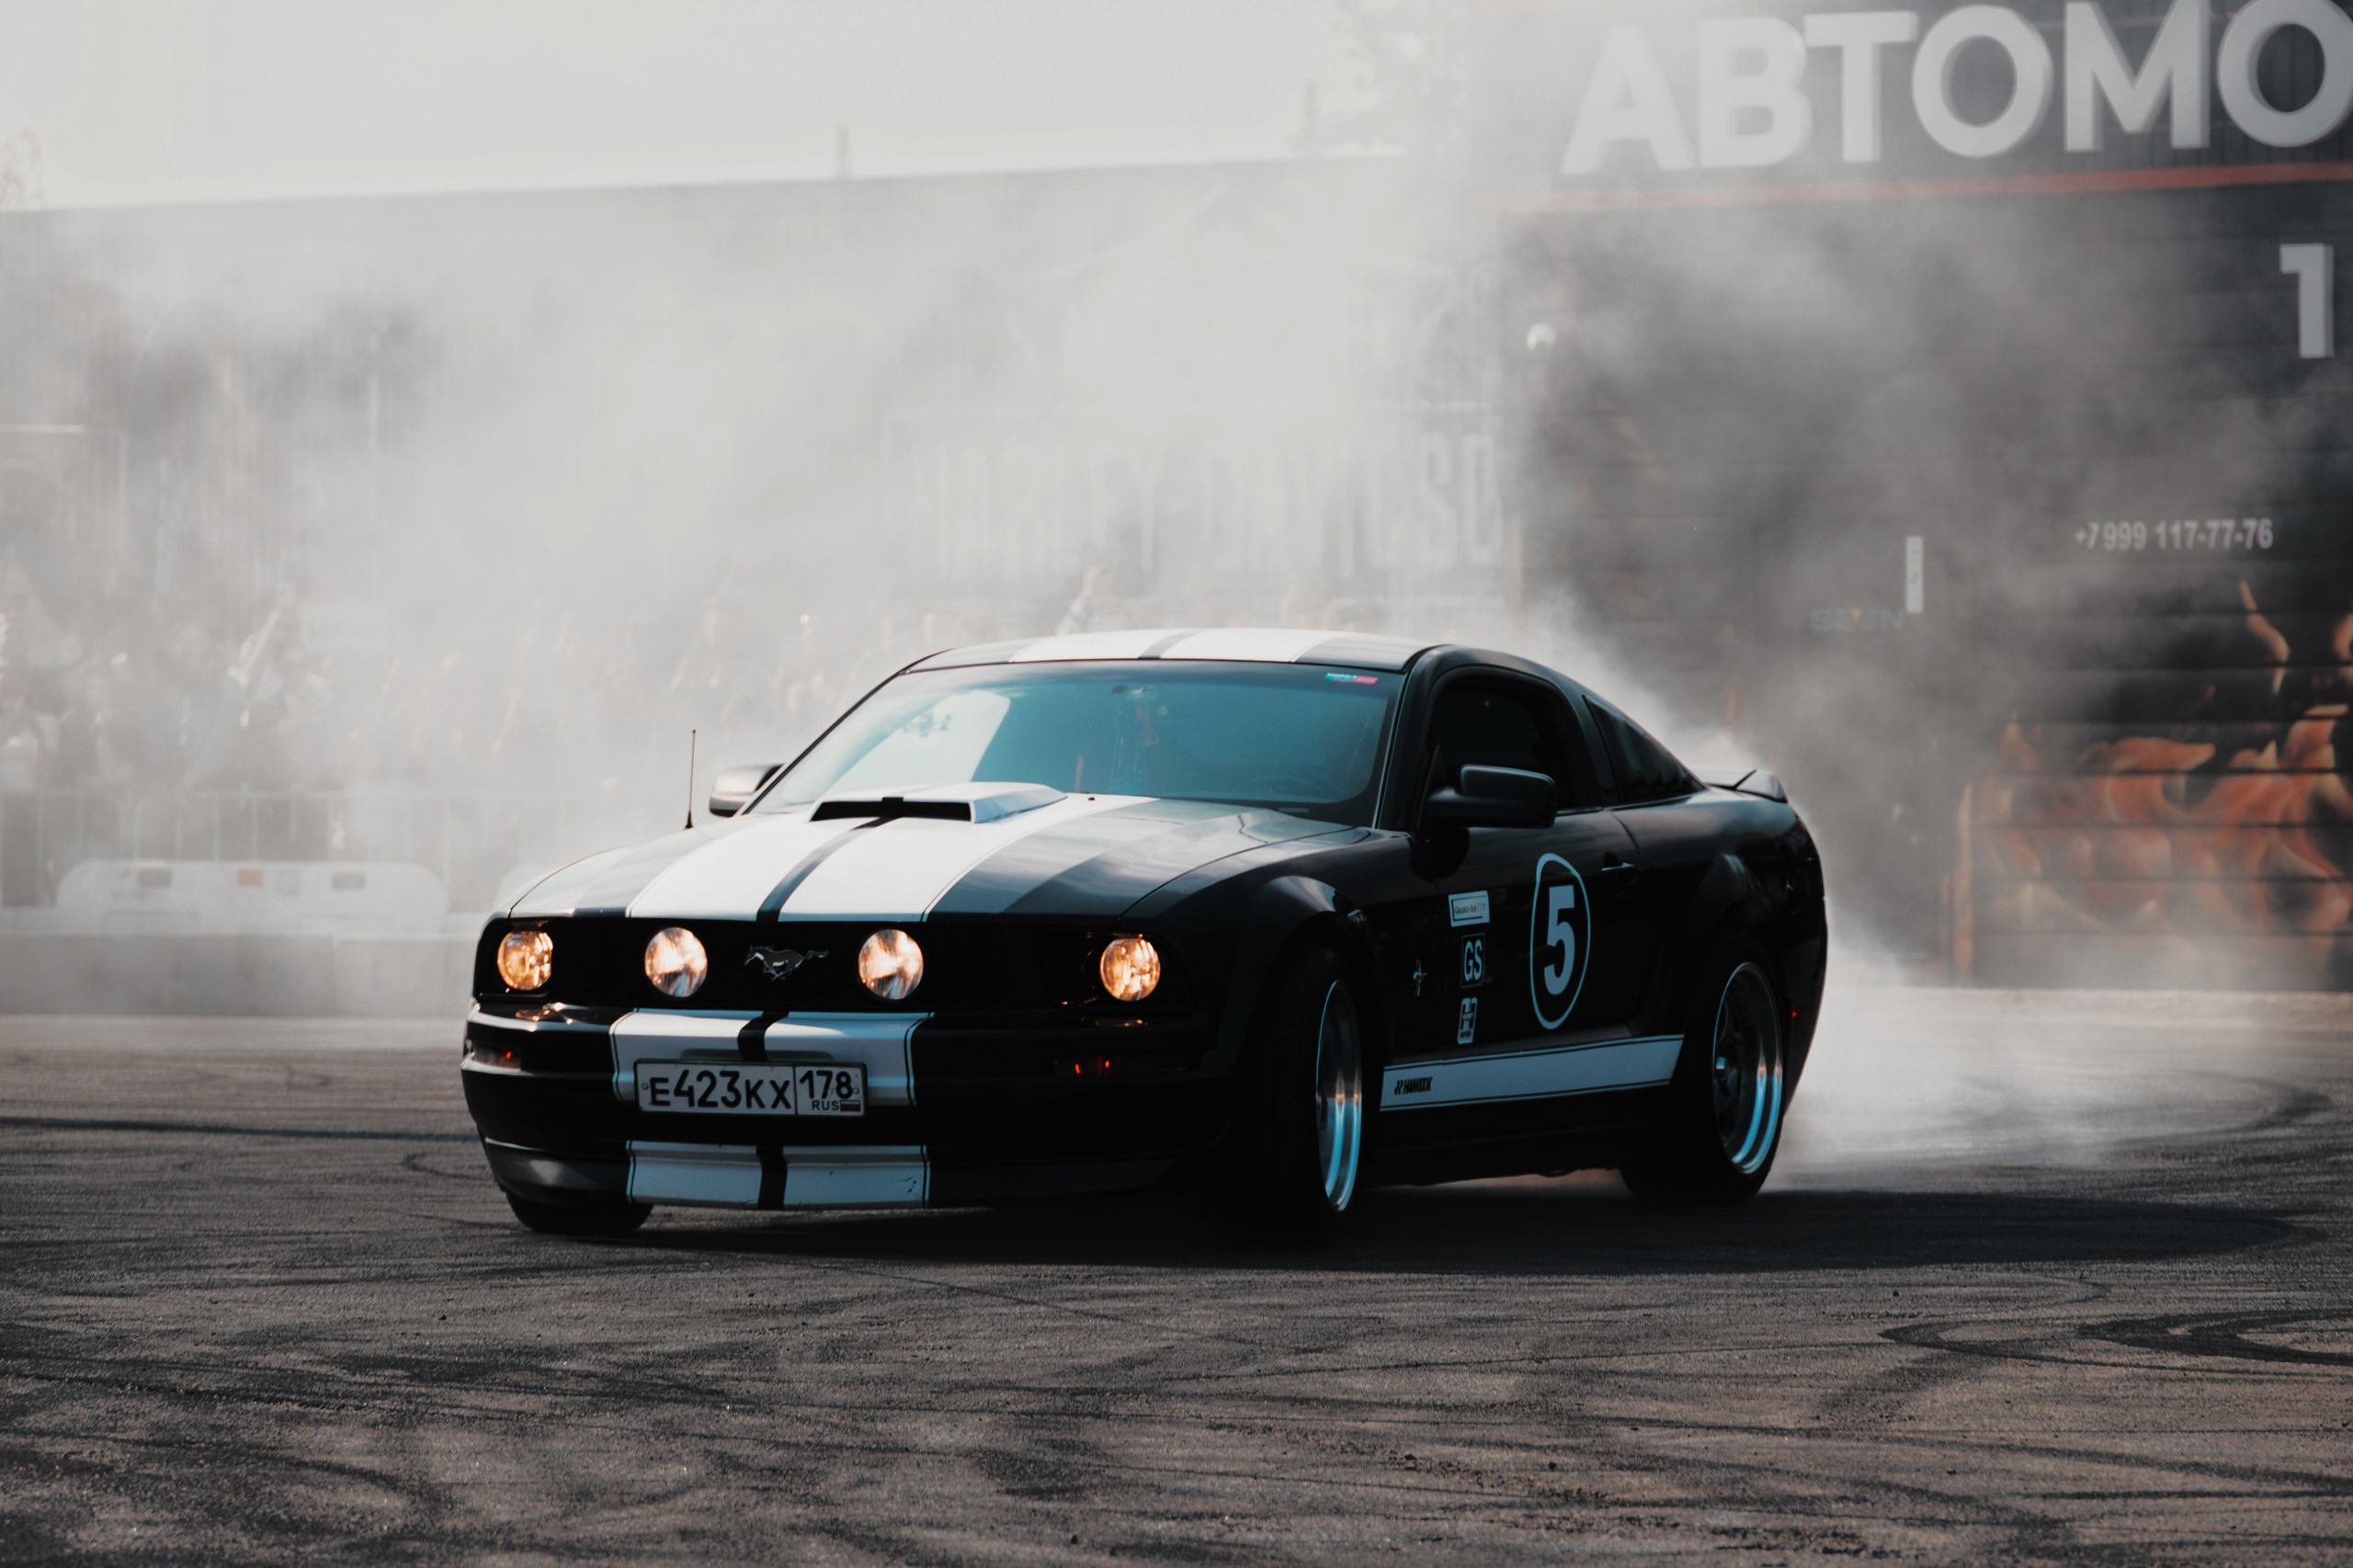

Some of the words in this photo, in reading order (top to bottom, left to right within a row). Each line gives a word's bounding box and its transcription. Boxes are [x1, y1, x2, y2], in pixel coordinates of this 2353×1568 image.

[1560, 0, 2353, 176] АВТОМО
[2279, 244, 2335, 359] 1
[2154, 517, 2274, 550] 117-77-76
[1463, 938, 1483, 982] GS
[1543, 884, 1575, 995] 5
[799, 1069, 854, 1100] 178
[812, 1099, 840, 1111] RUS
